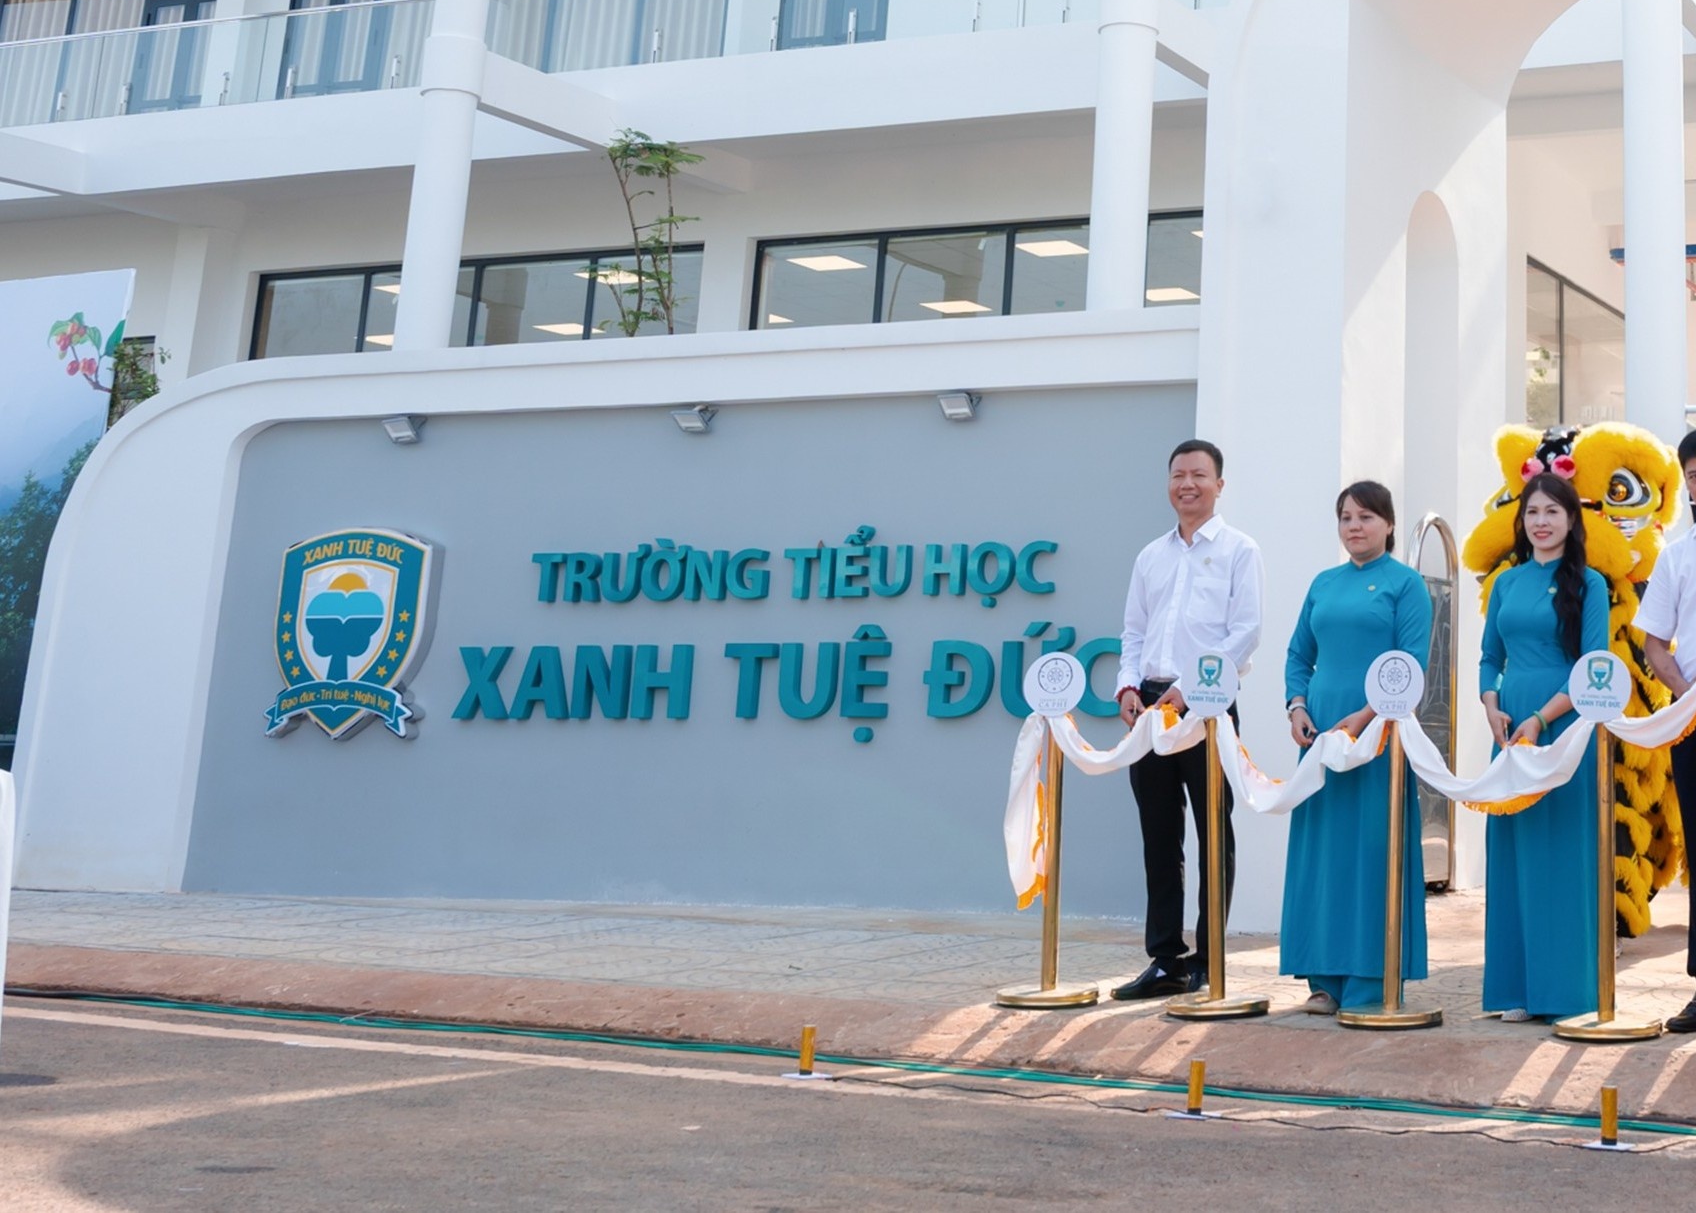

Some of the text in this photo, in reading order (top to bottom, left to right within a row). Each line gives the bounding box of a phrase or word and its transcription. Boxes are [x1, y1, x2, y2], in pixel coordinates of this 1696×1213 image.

[302, 537, 405, 565] XANH TUỆ ĐỨC
[531, 525, 1059, 609] TRƯỜNG TIỂU HỌC
[452, 620, 1122, 744] XANH TUỆ ĐỨC
